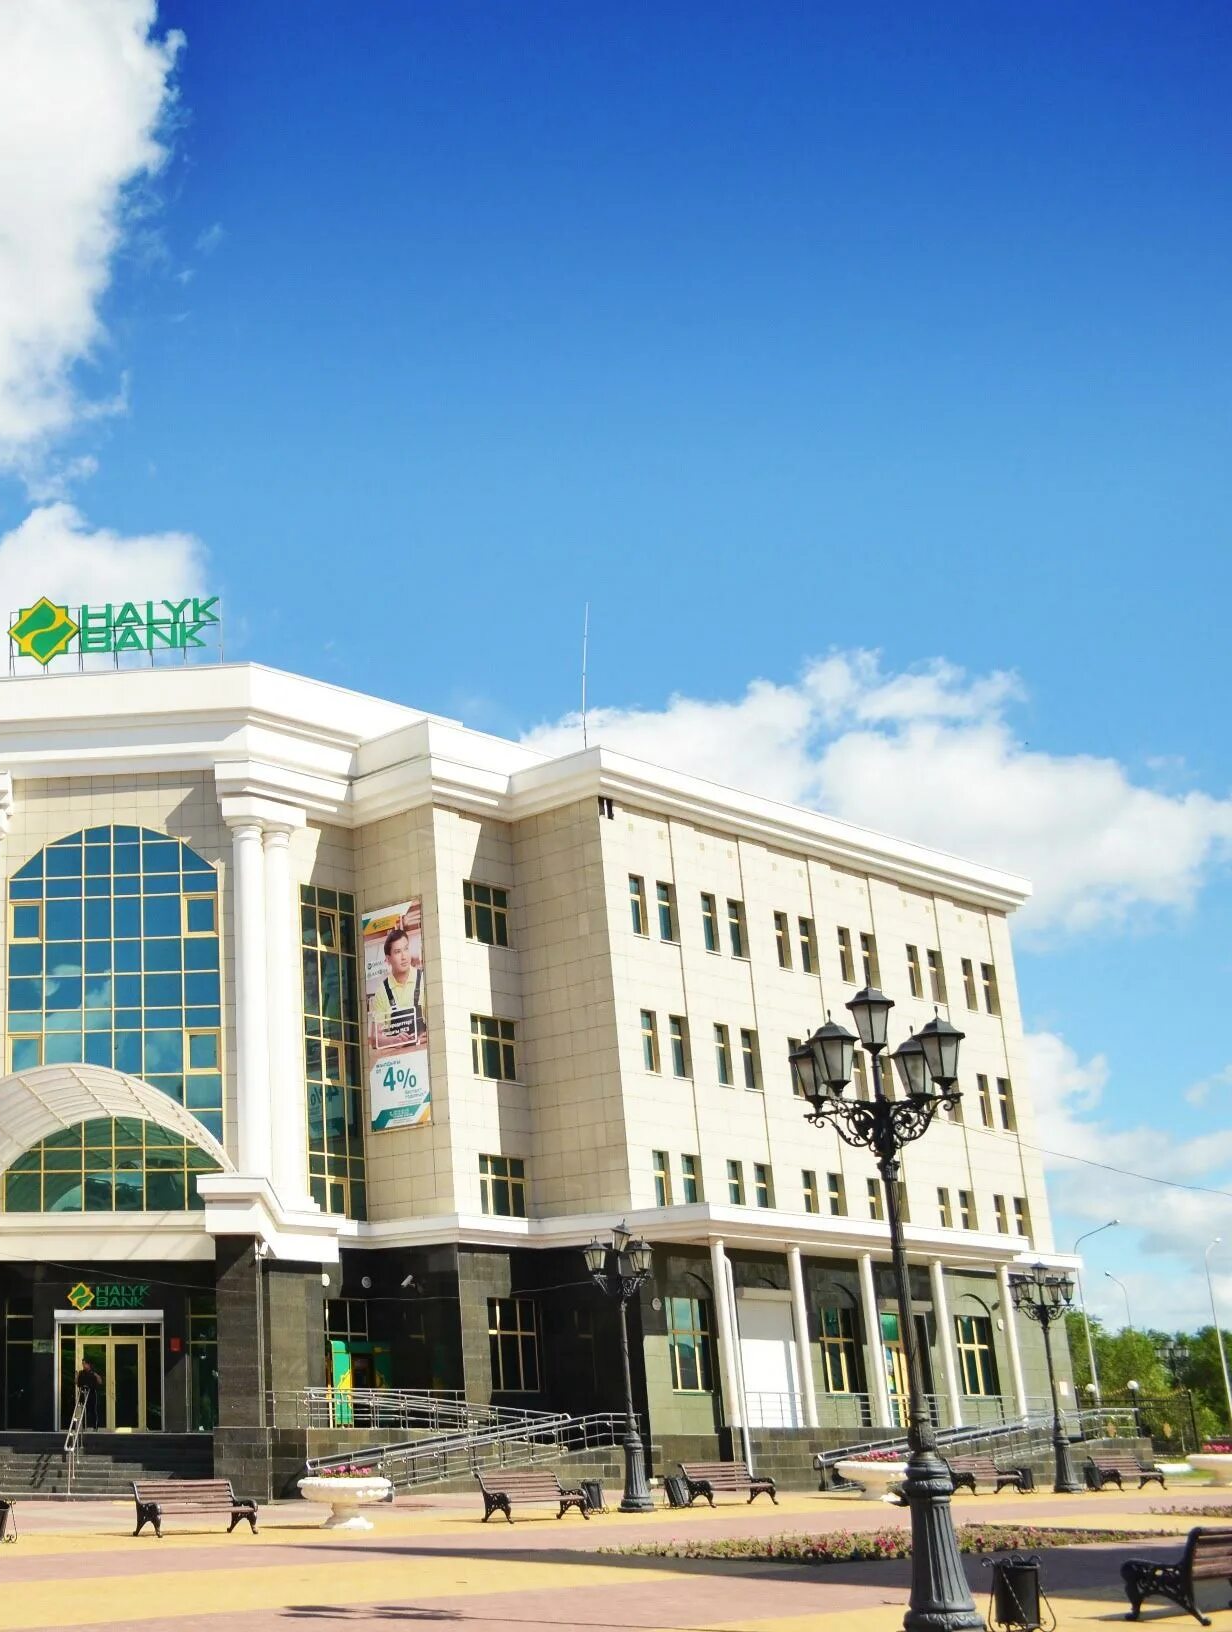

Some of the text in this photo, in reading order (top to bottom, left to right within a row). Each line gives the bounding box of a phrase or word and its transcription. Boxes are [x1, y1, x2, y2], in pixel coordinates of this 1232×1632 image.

[81, 597, 220, 628] HALYK
[81, 622, 206, 653] BANK
[382, 1066, 417, 1092] 4%
[95, 1285, 150, 1297] HALYK
[96, 1296, 145, 1308] BANK
